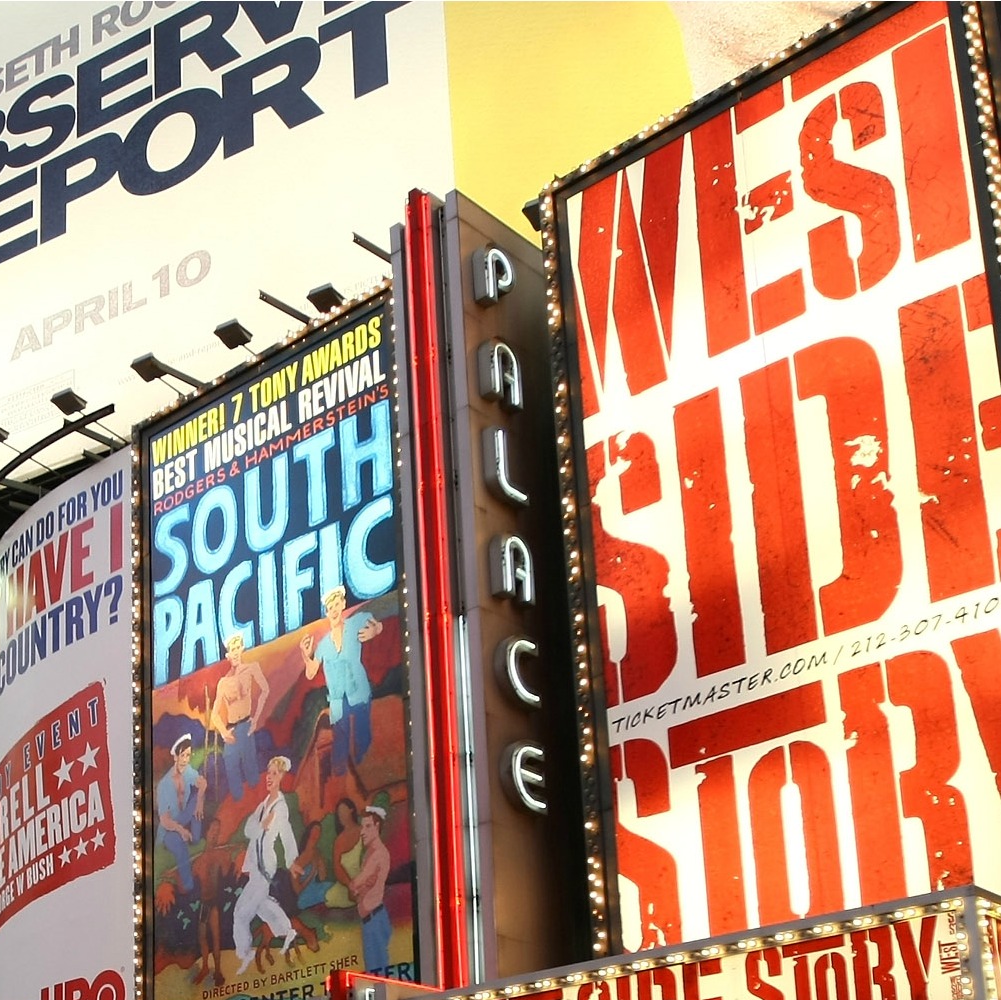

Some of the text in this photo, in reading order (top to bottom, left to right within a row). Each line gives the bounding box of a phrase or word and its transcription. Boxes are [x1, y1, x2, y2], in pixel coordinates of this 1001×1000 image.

[92, 0, 180, 46] RO
[572, 0, 971, 418] WEST
[10, 249, 213, 361] APRIL 10
[151, 402, 225, 468] WINNER!
[231, 392, 243, 425] 7
[249, 360, 299, 412] TONY
[301, 315, 382, 380] AWARDS
[152, 448, 198, 501] BEST
[204, 400, 292, 474] MUSICAL
[298, 349, 386, 423] REVIVAL
[153, 466, 226, 516] RODGERS
[245, 384, 389, 469] HAMMERSTEIN'S
[153, 399, 395, 597] SOUTH
[12, 470, 123, 568] CAN DO FOR YOU
[7, 517, 94, 640] HAVE
[153, 493, 396, 689] PACIFIC
[22, 697, 99, 773] EVENT
[612, 649, 827, 734] TICKETMASTER.COM
[8, 781, 104, 878] AMERICA
[17, 873, 26, 894] W
[27, 853, 54, 885] BUSH
[202, 955, 359, 1000] DIRECTED BY BARTLETT SHER
